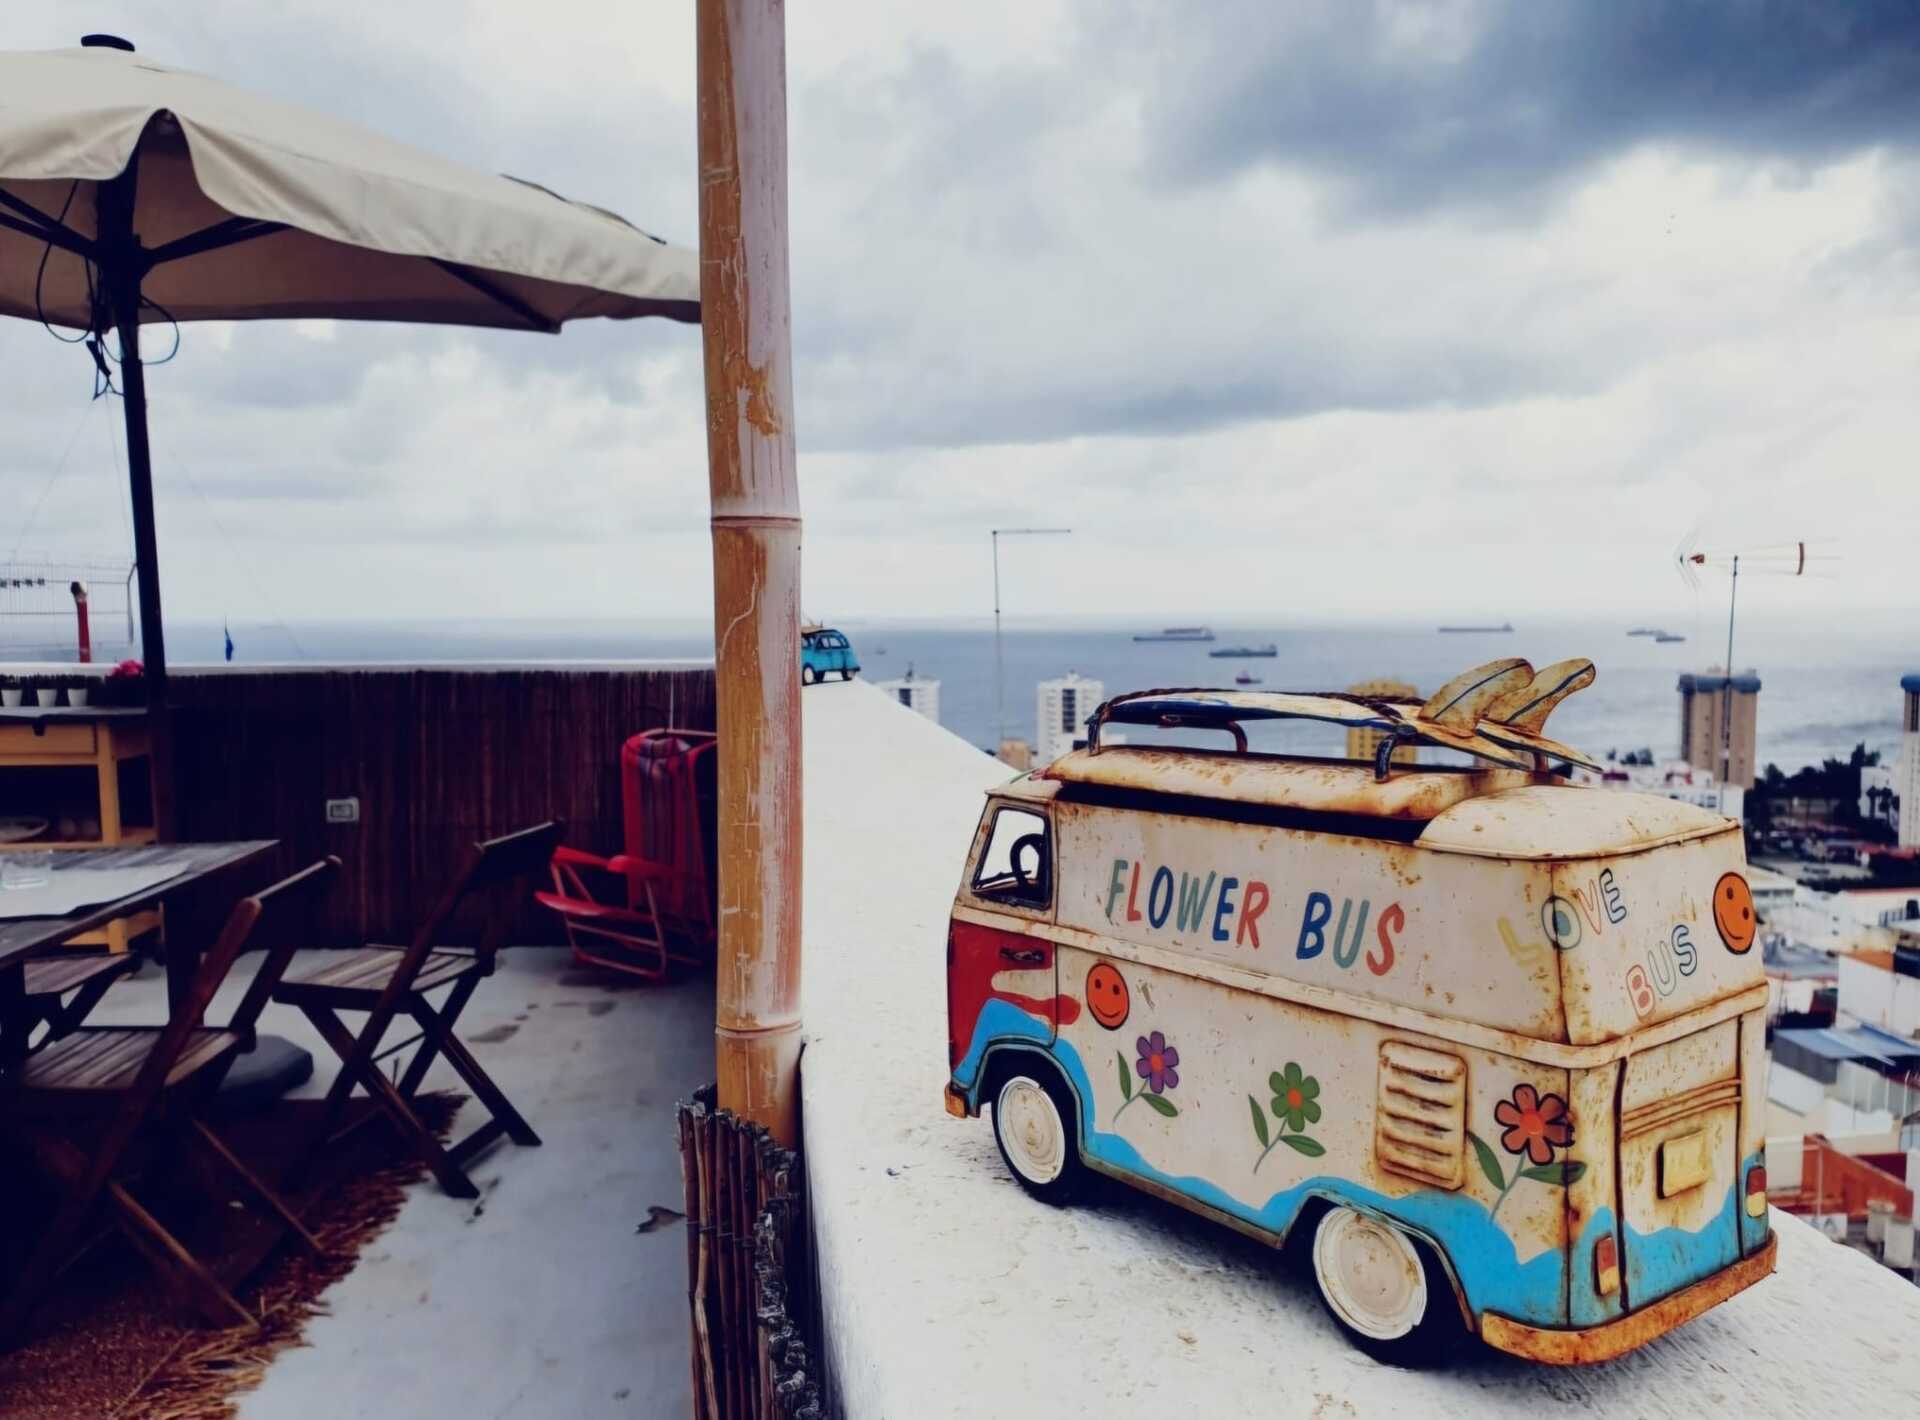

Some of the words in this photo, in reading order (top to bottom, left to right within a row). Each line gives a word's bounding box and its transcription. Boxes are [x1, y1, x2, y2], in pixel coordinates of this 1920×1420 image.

[1105, 860, 1269, 948] FLOWER
[1296, 892, 1405, 976] BUS
[1497, 868, 1627, 966] LOVE
[1626, 924, 1697, 1018] BUS
